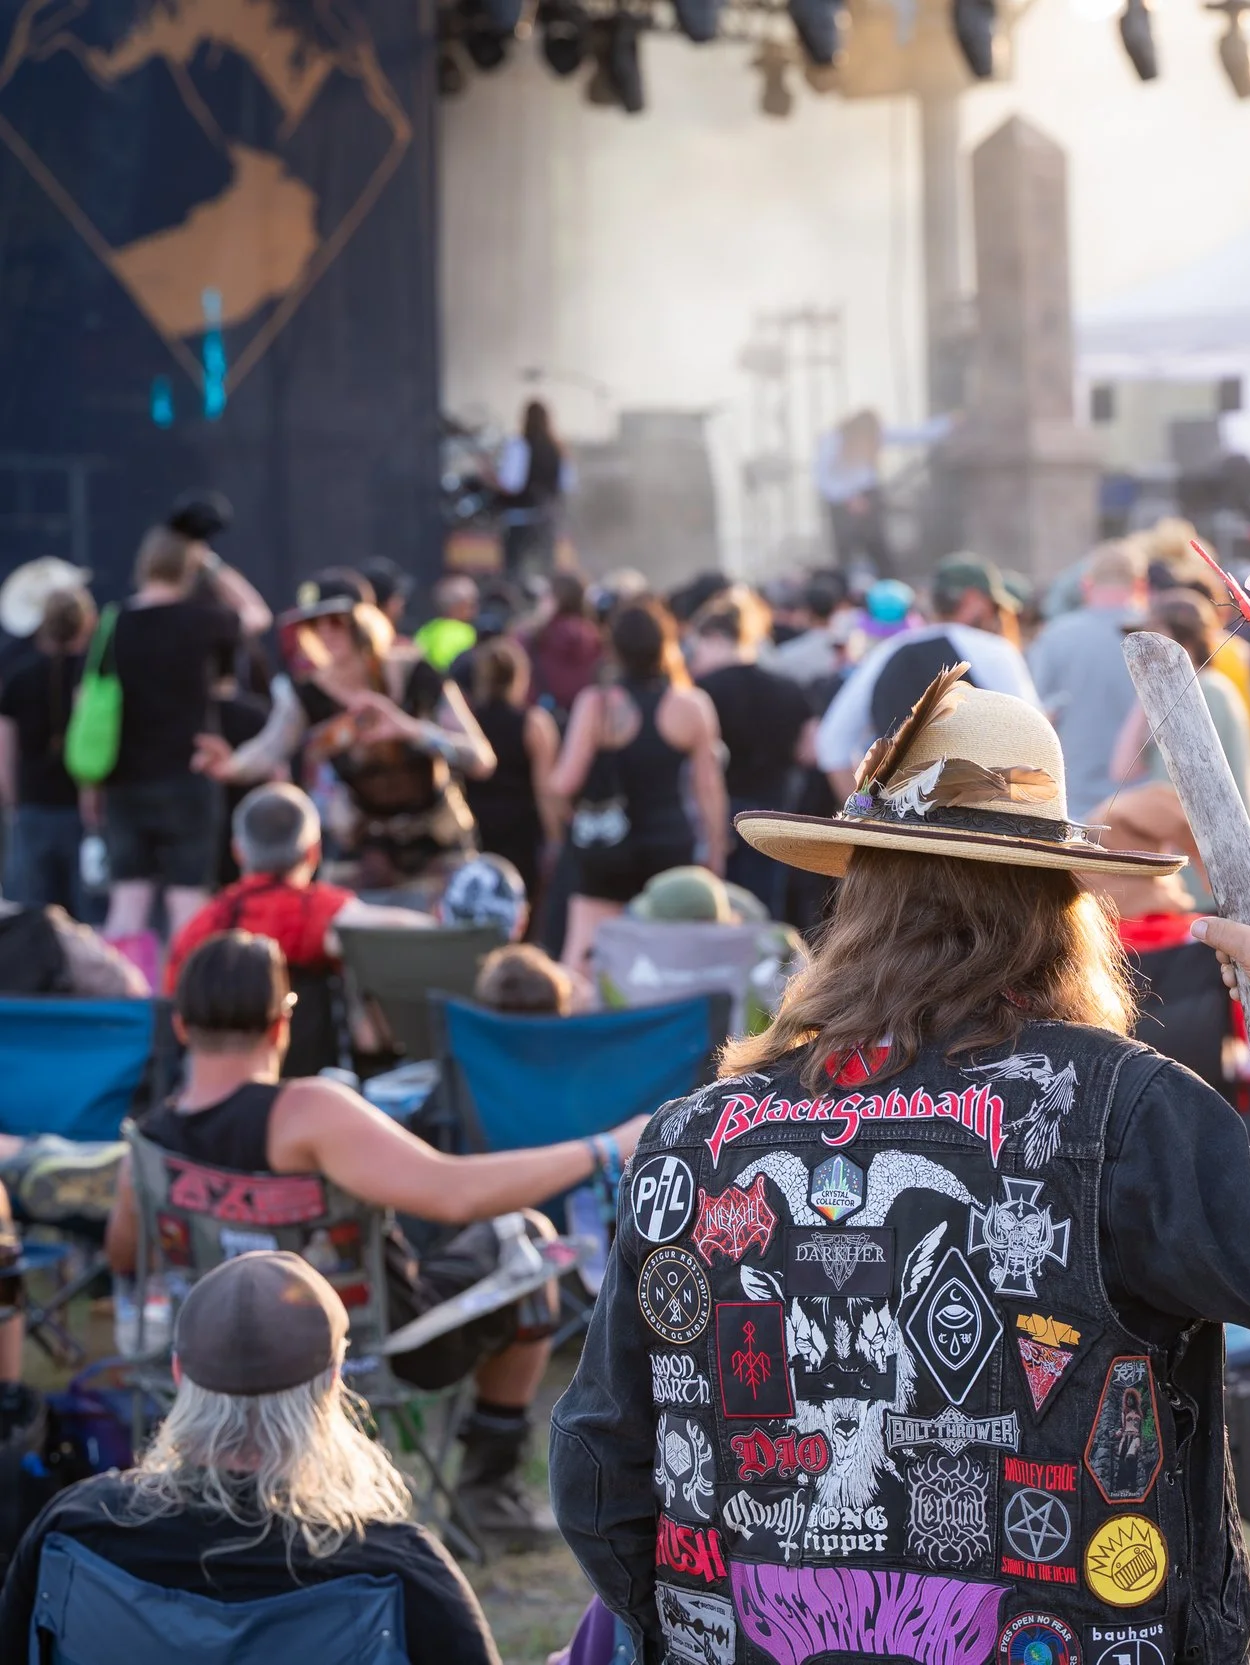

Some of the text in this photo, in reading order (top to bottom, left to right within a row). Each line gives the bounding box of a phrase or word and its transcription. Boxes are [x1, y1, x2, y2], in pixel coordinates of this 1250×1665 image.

[704, 1083, 1008, 1169] Black Sabbath
[636, 1175, 685, 1213] PiL
[815, 1198, 855, 1207] COLLECTOR
[821, 1190, 849, 1198] CRYSTAL
[650, 1250, 676, 1267] SIGUR
[795, 1245, 886, 1263] DARKHER
[698, 1278, 708, 1300] 2017
[670, 1331, 683, 1340] OG
[1113, 1362, 1146, 1372] CASTLE
[1113, 1370, 1146, 1384] RAT
[892, 1419, 1013, 1443] BOLT THROWER
[731, 1426, 830, 1481] DIO
[1045, 1464, 1077, 1492] CRÜE
[655, 1511, 728, 1583] RUSH
[1001, 1555, 1077, 1584] SHOUT AT THE DEVIL
[1000, 1615, 1072, 1653] EYES OPEN NO FEAR
[1092, 1623, 1164, 1641] bauhaus
